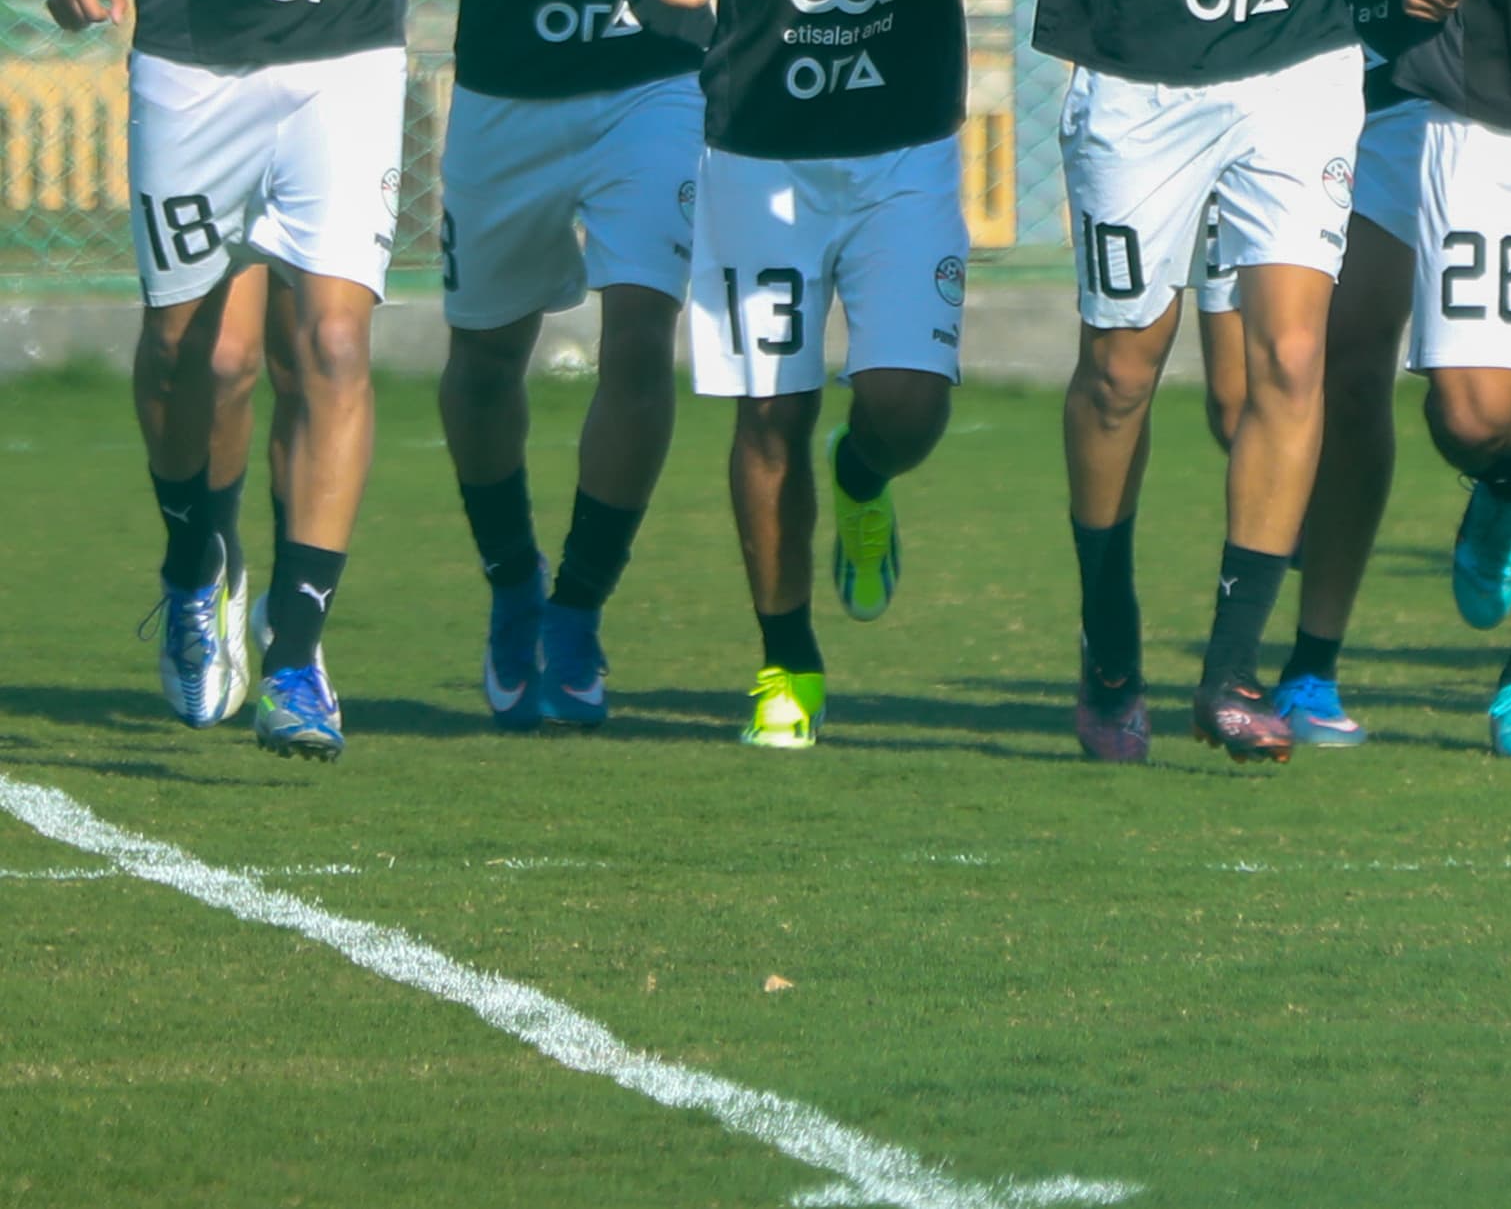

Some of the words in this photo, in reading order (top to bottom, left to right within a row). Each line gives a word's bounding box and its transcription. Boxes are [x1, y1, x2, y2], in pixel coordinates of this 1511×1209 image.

[783, 24, 859, 46] etisalat
[861, 12, 893, 39] and
[141, 192, 221, 271] 18
[1082, 209, 1146, 299] 10
[723, 266, 804, 357] 13
